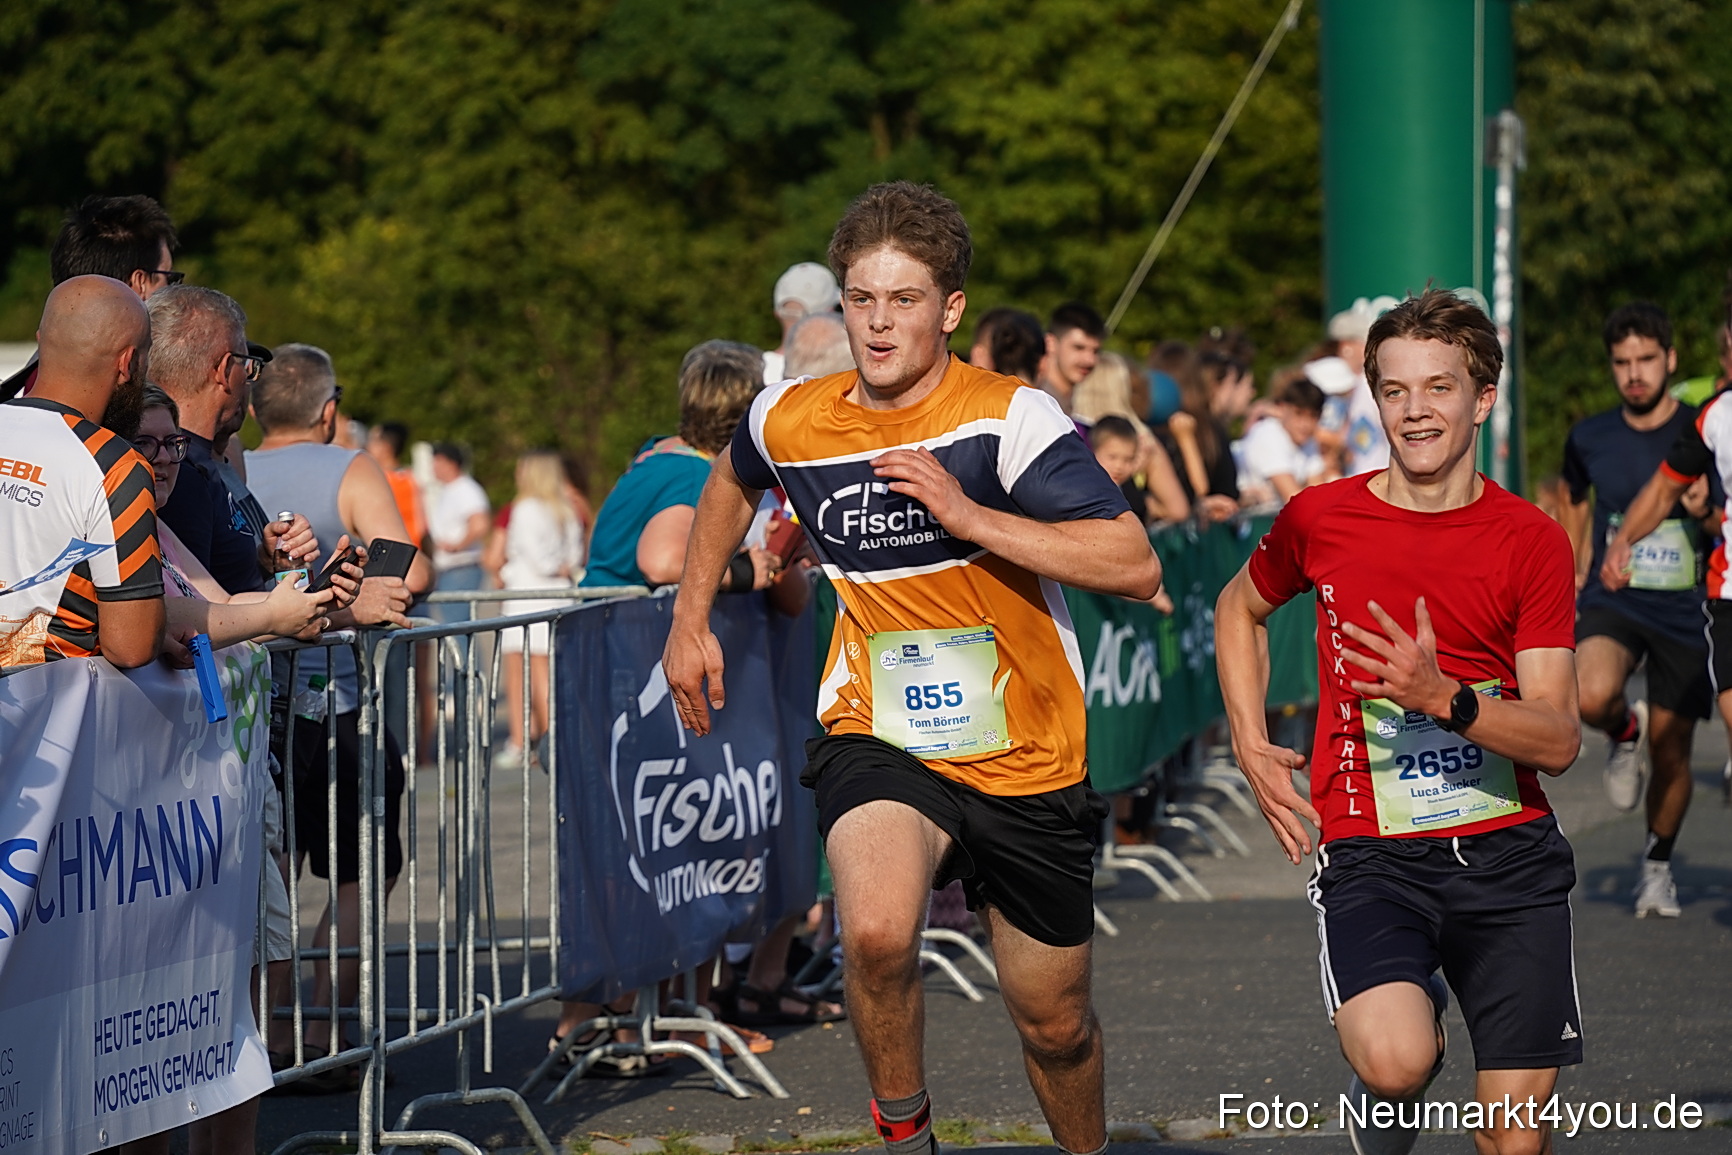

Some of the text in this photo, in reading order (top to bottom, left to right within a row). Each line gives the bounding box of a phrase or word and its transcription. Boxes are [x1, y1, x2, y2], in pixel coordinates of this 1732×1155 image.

[859, 528, 953, 550] AUTOMOBIL
[899, 654, 934, 664] Firmenlauf
[905, 681, 963, 711] 855
[908, 715, 971, 729] Tom Börner
[1395, 744, 1483, 780] 2659
[1411, 777, 1482, 798] Luca Sucker
[94, 989, 221, 1057] HEUTE GEDACHT,
[94, 1041, 236, 1116] MORGEN GEMACHT.
